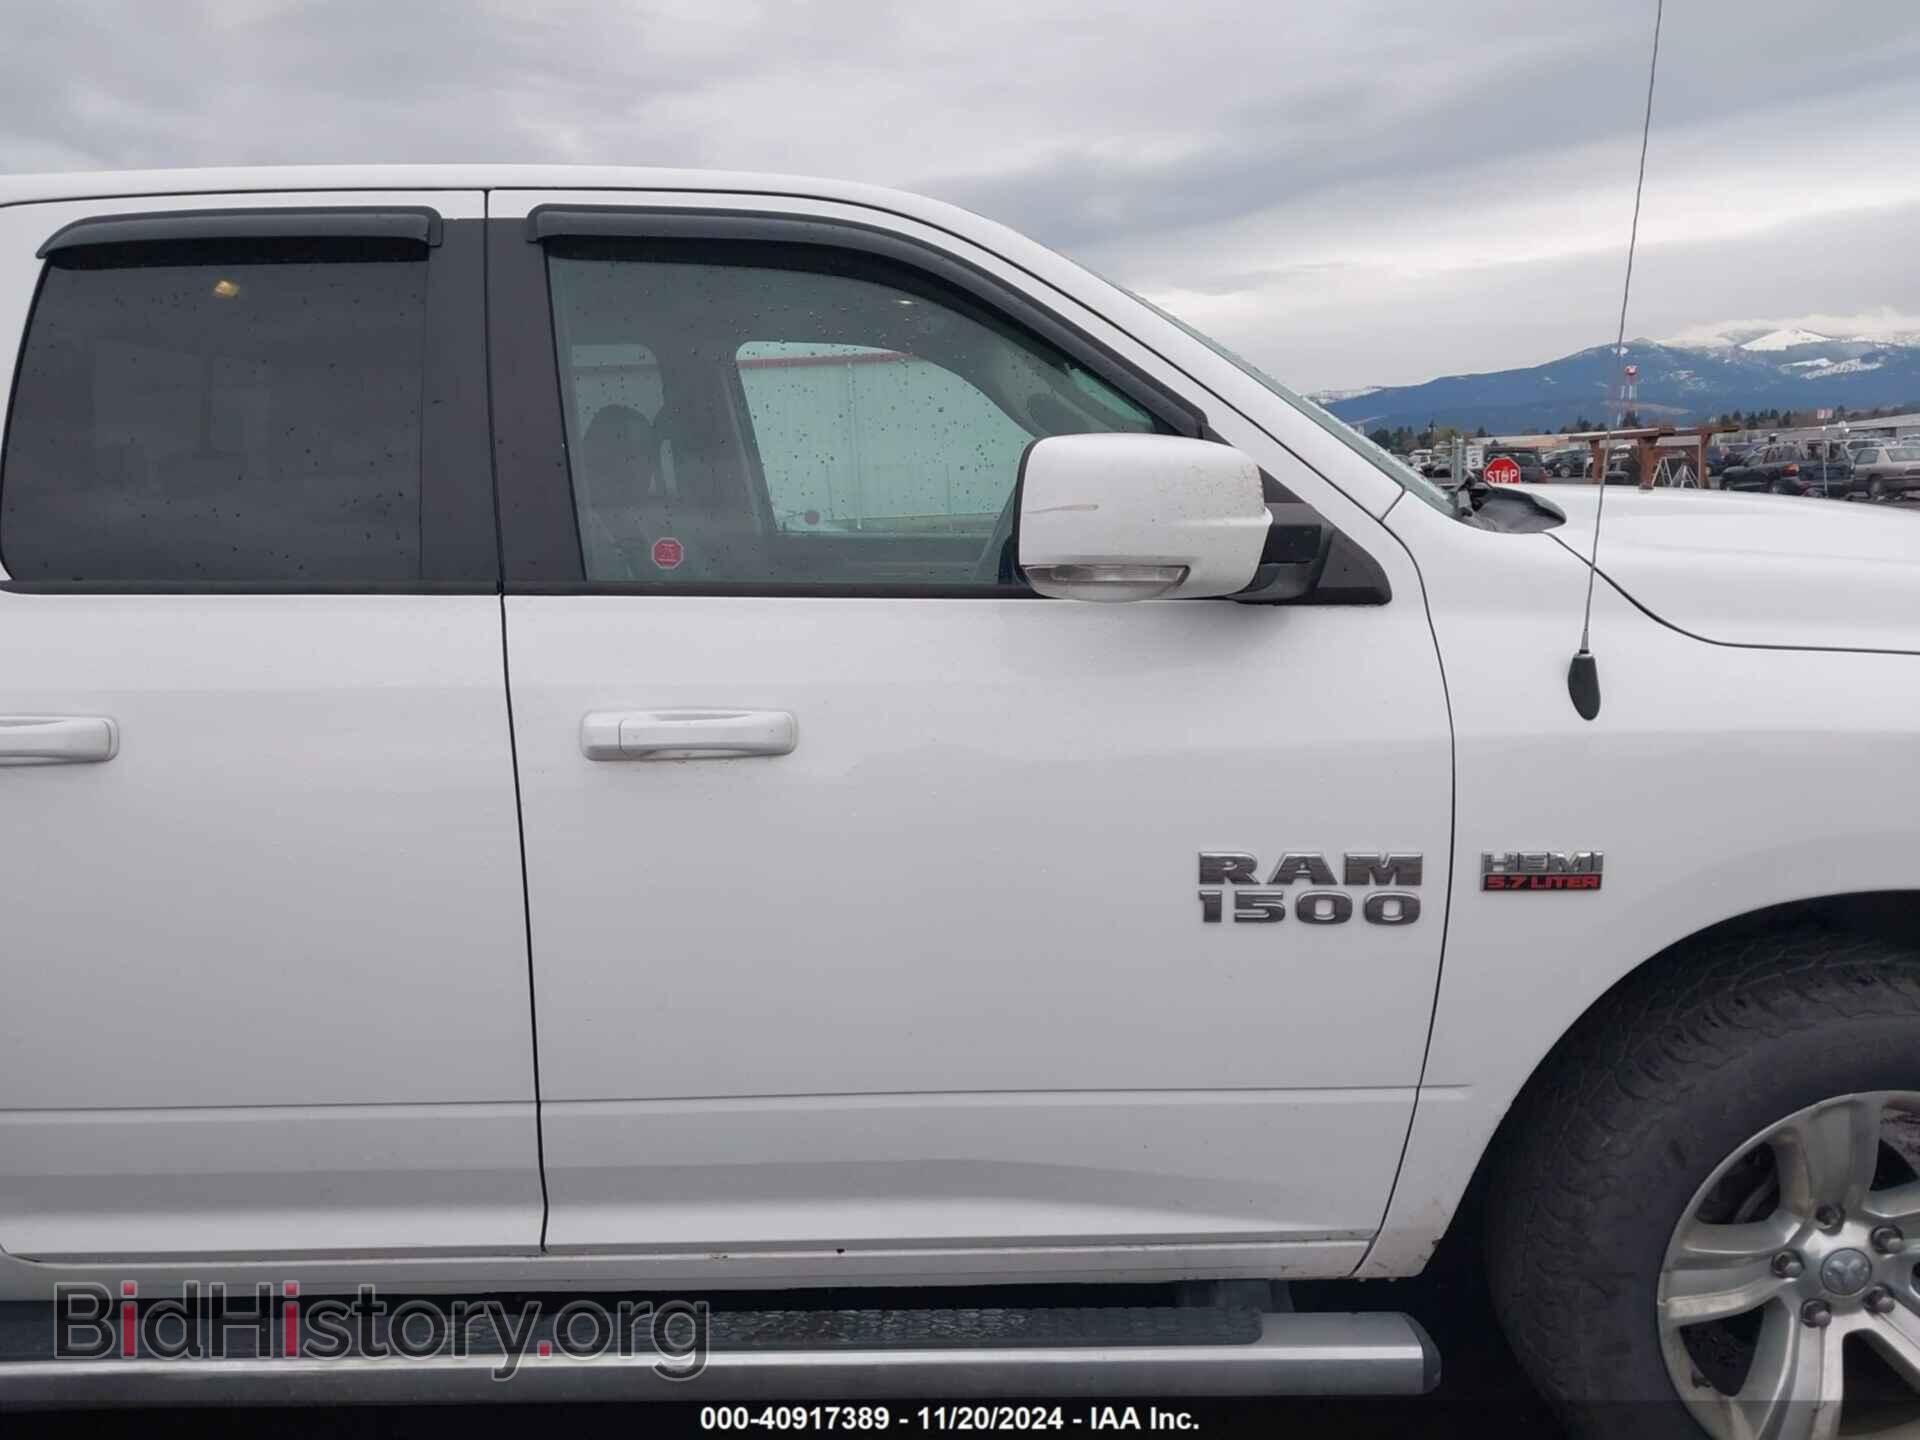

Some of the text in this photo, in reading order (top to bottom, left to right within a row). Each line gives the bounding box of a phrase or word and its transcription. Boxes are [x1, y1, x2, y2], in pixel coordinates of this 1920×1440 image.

[1487, 470, 1518, 483] STOP
[1199, 852, 1423, 886] RAM
[1481, 852, 1604, 873] HEMI
[1487, 875, 1600, 889] 5.7 LITER
[1199, 890, 1421, 925] 1500
